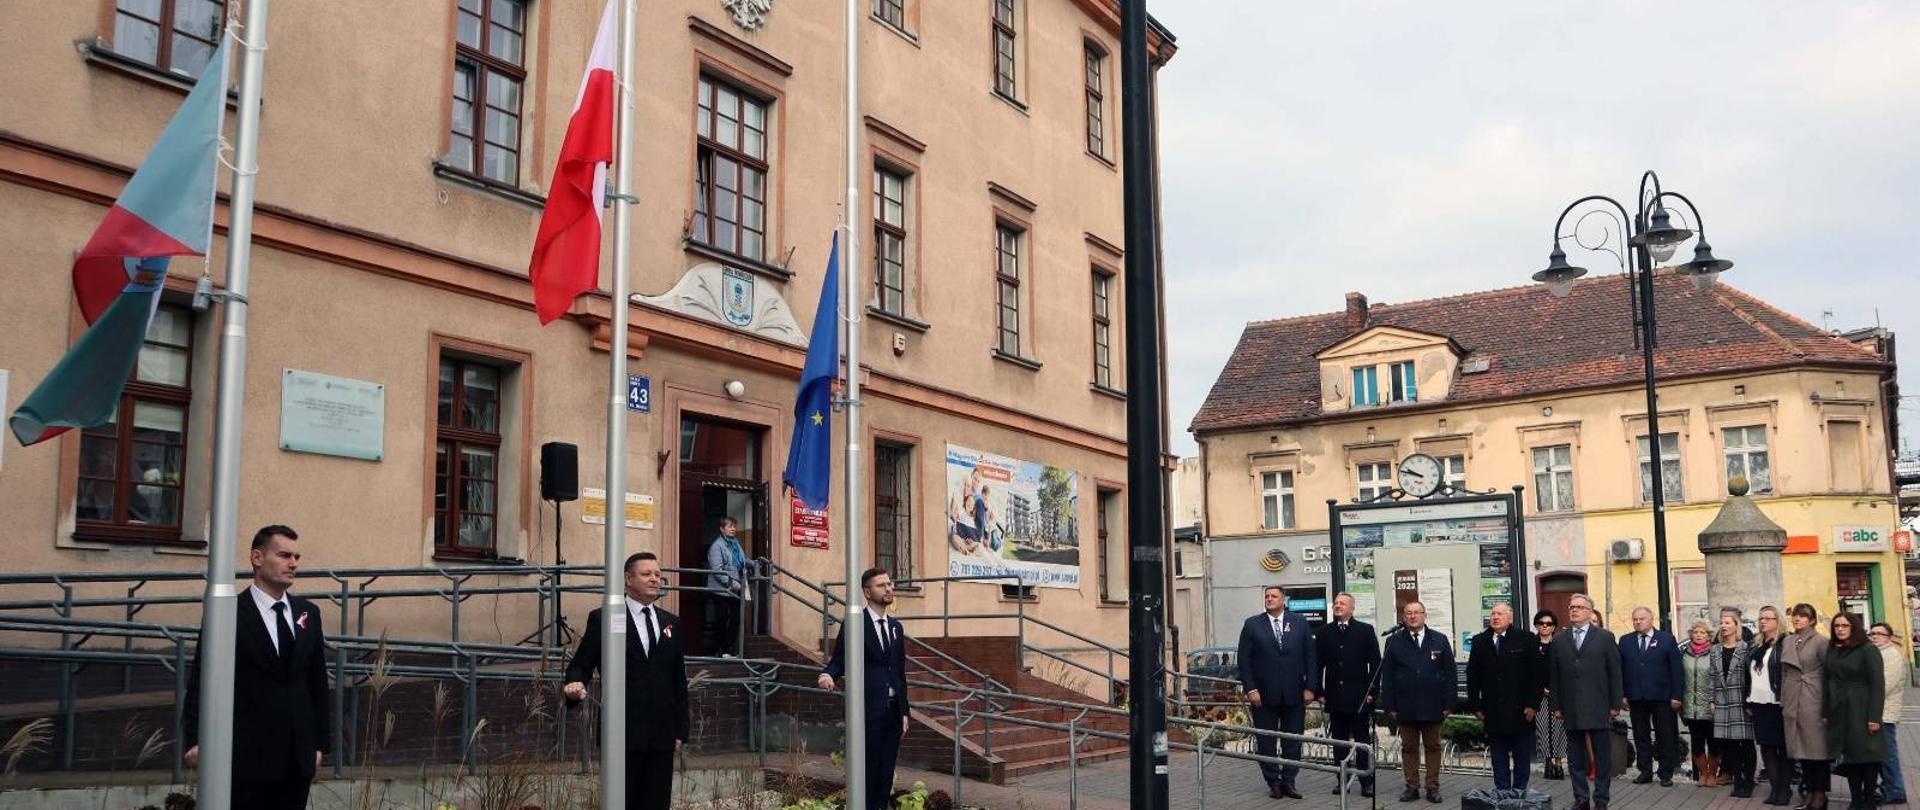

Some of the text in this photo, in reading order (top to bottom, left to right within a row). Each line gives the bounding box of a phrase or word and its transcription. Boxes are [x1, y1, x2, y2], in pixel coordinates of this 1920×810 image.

[630, 386, 648, 404] 43
[1853, 529, 1878, 542] abc
[1302, 546, 1331, 561] GR
